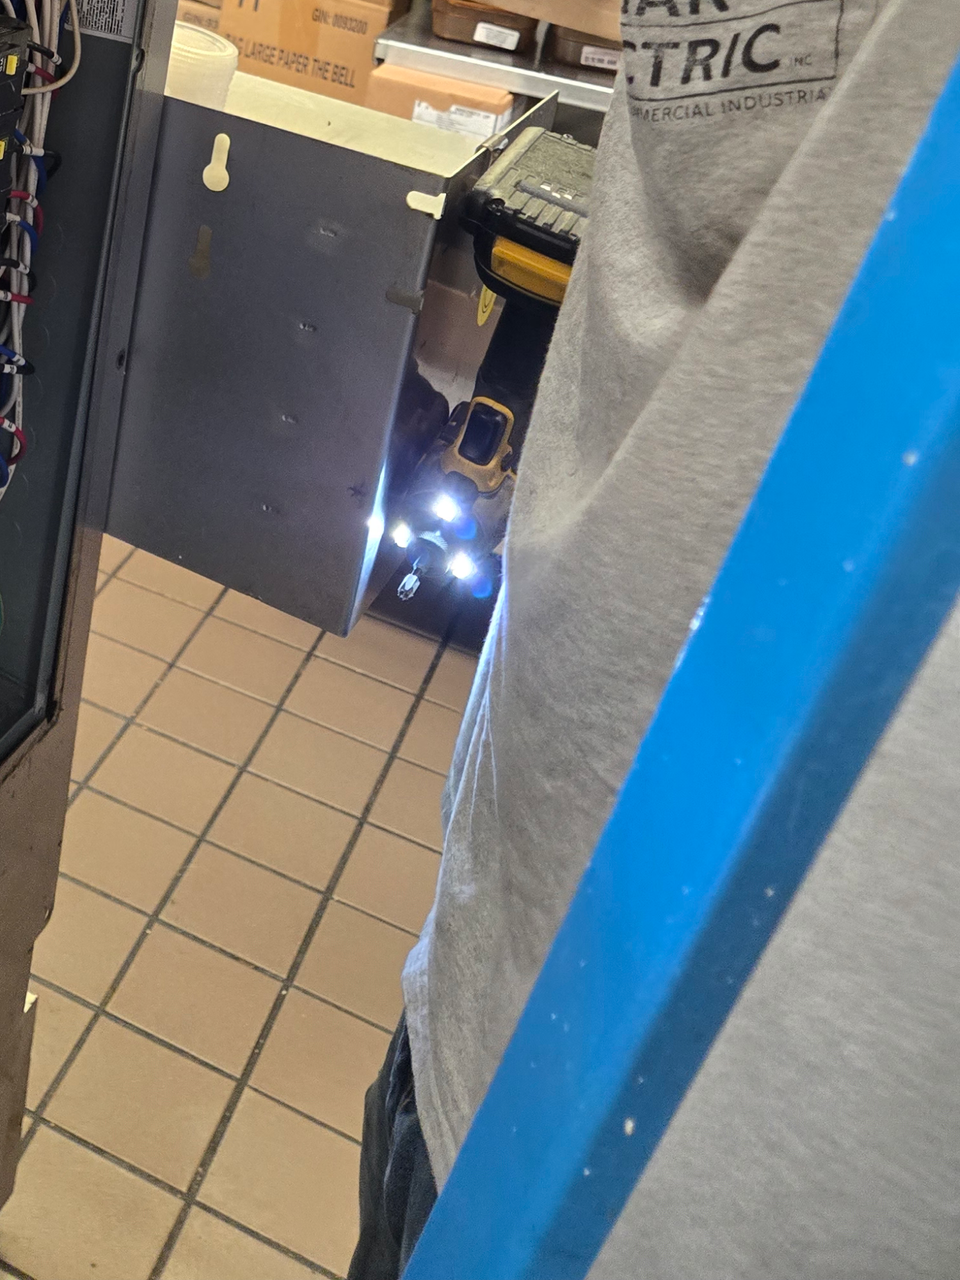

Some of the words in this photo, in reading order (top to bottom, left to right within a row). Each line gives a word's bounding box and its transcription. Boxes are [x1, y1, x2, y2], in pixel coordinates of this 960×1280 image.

[244, 39, 277, 66] LARGE
[278, 48, 310, 76] PAPER
[311, 57, 332, 81] THE
[332, 64, 357, 89] BELL
[721, 87, 836, 114] INDUSTRIA
